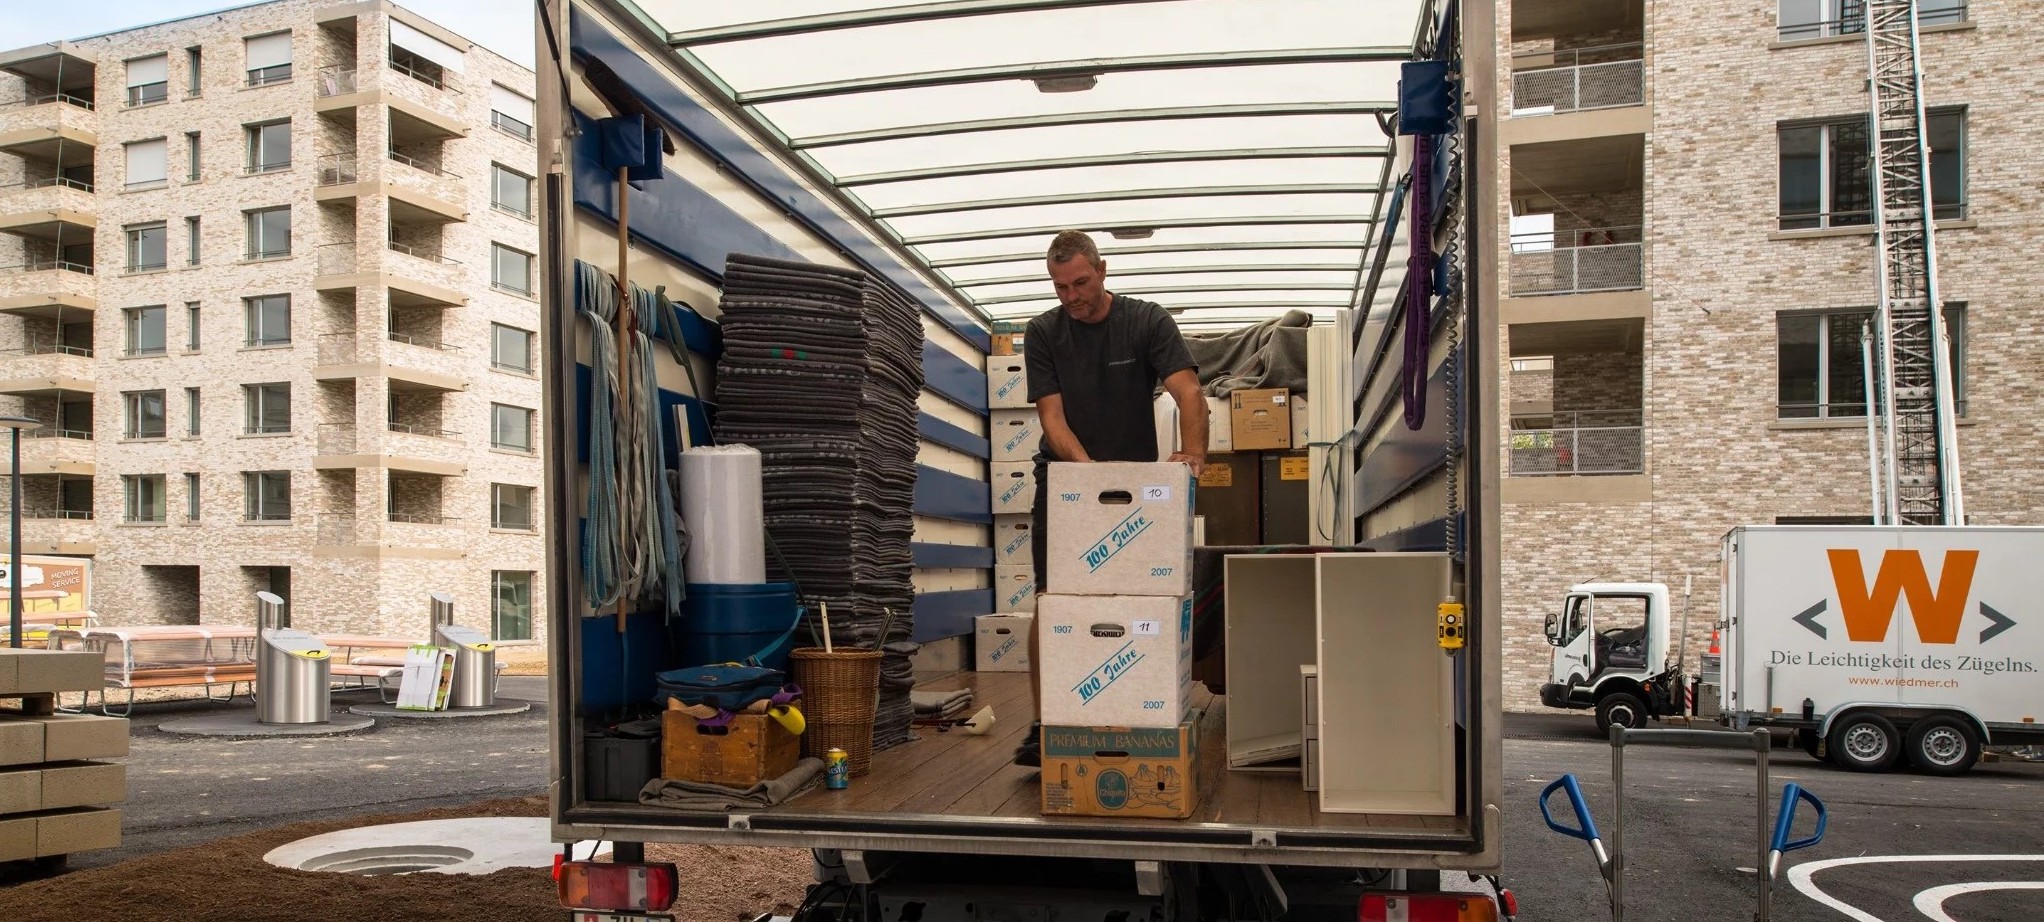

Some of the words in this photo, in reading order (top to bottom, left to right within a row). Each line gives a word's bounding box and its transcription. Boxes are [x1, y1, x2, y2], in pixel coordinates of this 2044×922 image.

[1419, 164, 1430, 205] PLUS
[1419, 213, 1430, 268] SUPRA
[1061, 493, 1081, 501] 1907
[1149, 488, 1162, 499] 10
[1085, 544, 1109, 569] 100
[1112, 516, 1146, 548] Jahre
[51, 567, 79, 580] MOVING
[1151, 568, 1173, 576] 2007
[52, 576, 80, 589] SERVICE
[1827, 549, 1980, 644] W
[1053, 626, 1073, 634] 1907
[1139, 622, 1150, 632] 11
[1771, 650, 1802, 665] Die
[1808, 651, 1916, 672] Leichtigkeit
[1921, 655, 1951, 670] des
[1957, 656, 2038, 676] Zügelns.
[1077, 676, 1101, 701] 100
[1104, 649, 1137, 680] Jahre
[1849, 676, 1959, 689] www.wiedmer.ch
[1143, 701, 1165, 709] 2007
[1050, 734, 1107, 748] PREMIUM
[1115, 734, 1175, 748] BANANAS
